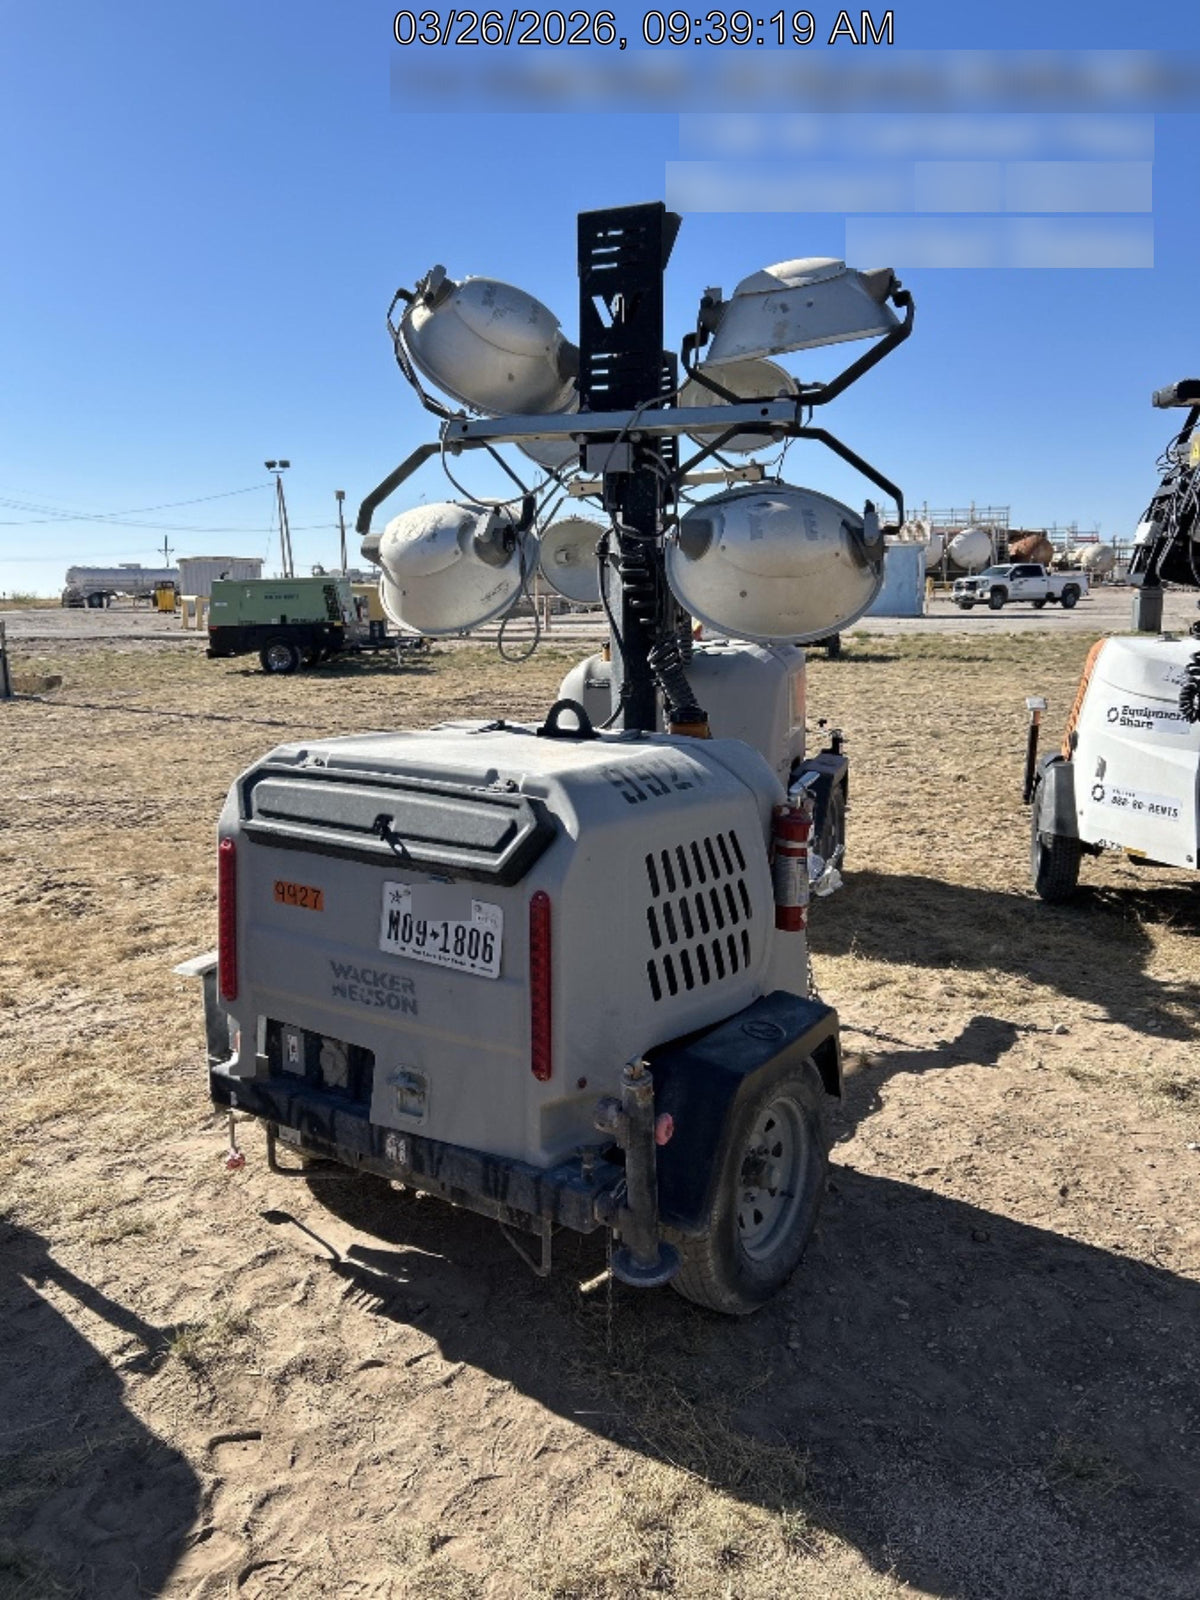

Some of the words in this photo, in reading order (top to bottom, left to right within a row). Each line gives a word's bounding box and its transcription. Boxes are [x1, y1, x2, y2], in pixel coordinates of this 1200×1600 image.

[1119, 716, 1154, 730] Share
[275, 881, 321, 909] 9927
[329, 960, 416, 995] WACKER
